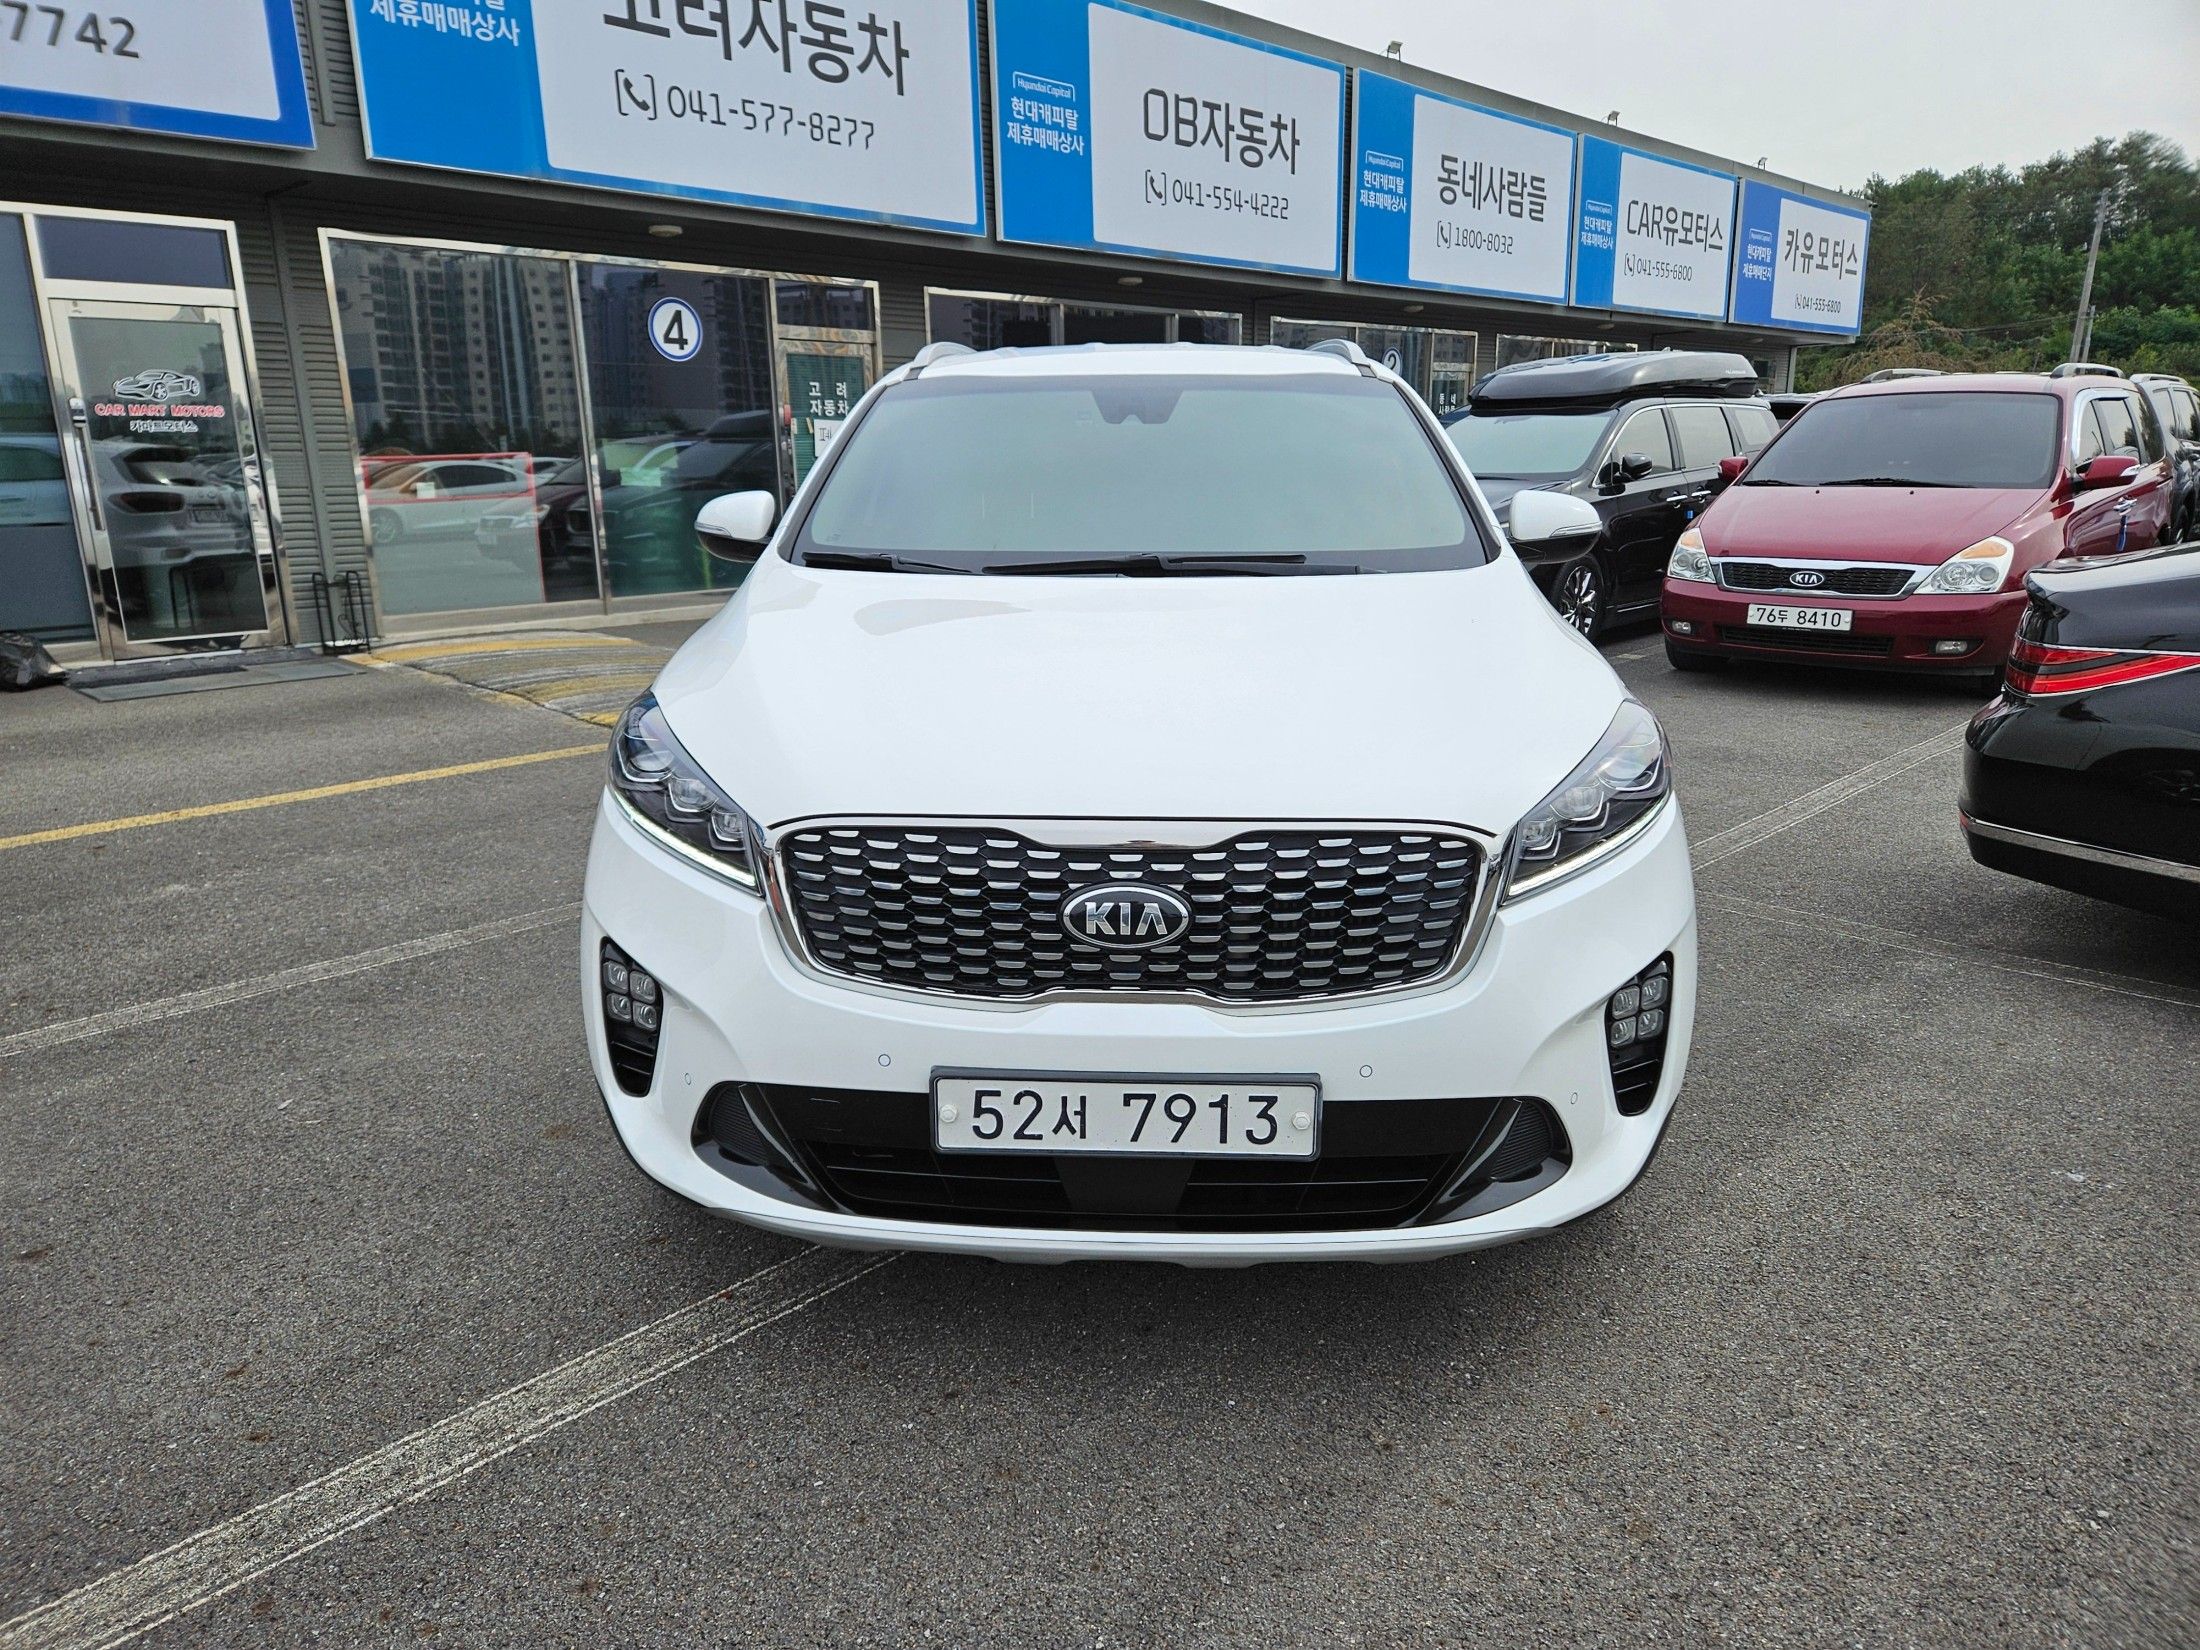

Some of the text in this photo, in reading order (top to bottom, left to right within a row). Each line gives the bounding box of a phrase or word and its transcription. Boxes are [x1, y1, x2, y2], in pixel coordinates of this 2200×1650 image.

[667, 85, 875, 150] 041-577-8277
[1011, 96, 1079, 131] 현대캐피탈
[1007, 121, 1084, 156] 제휴매매상사
[1143, 88, 1300, 175] OB자동차
[1172, 179, 1289, 220] 041-554-4222
[1363, 170, 1404, 194] 현대캐피탈
[1437, 154, 1547, 222] 동네사람들
[1360, 189, 1407, 214] 제휴매매상사
[1455, 227, 1513, 254] 1800-8032
[1627, 200, 1723, 252] CAR유모터스
[1636, 258, 1692, 282] 041-555-6800
[1784, 228, 1858, 280] 카유모터스
[1802, 295, 1841, 313] 041-555-6800
[663, 309, 688, 350] 4
[95, 403, 225, 417] CAR MART MOTORS
[810, 399, 849, 417] 자동차
[1795, 573, 1818, 584] KIA
[1756, 607, 1841, 627] 76두 8410
[1084, 901, 1168, 936] KIA
[972, 1089, 1279, 1145] 52서 7913
